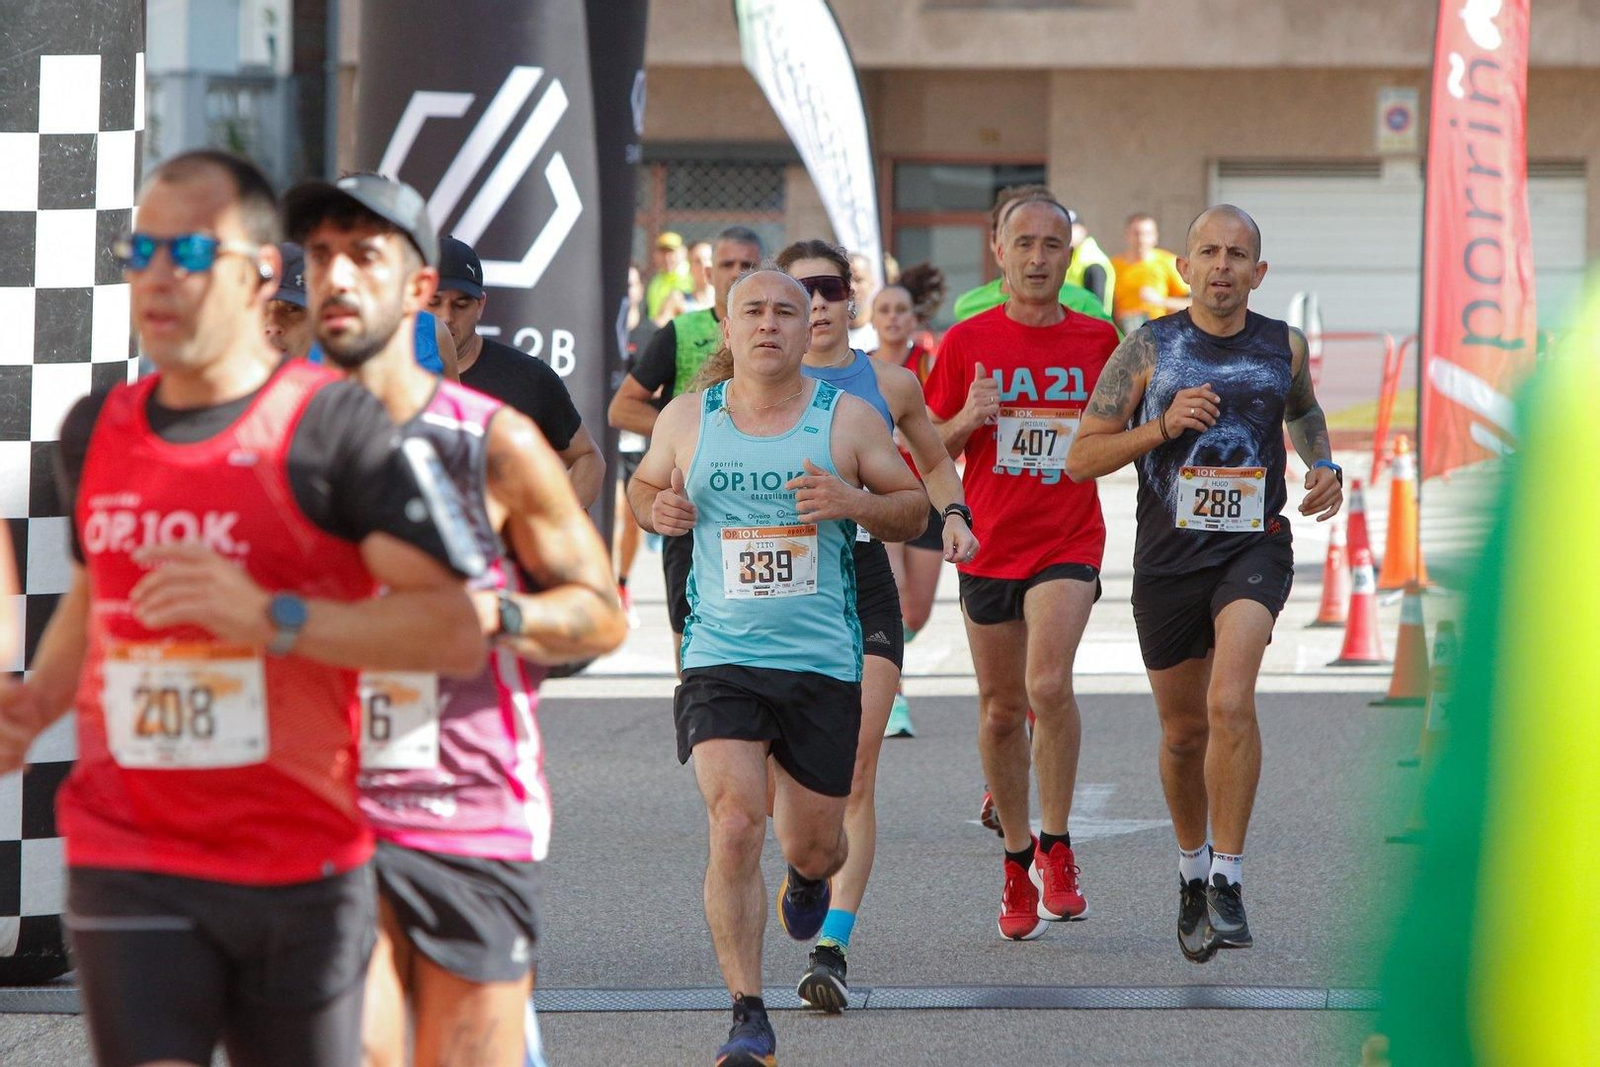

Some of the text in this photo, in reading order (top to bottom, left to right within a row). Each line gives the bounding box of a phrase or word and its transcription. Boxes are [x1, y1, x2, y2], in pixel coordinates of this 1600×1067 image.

[992, 366, 1089, 402] LA 21
[1011, 428, 1059, 457] 407
[1211, 480, 1229, 488] HUGO
[1193, 488, 1242, 518] 288
[756, 541, 775, 549] TITO
[739, 550, 793, 584] 339
[133, 686, 215, 739] 208
